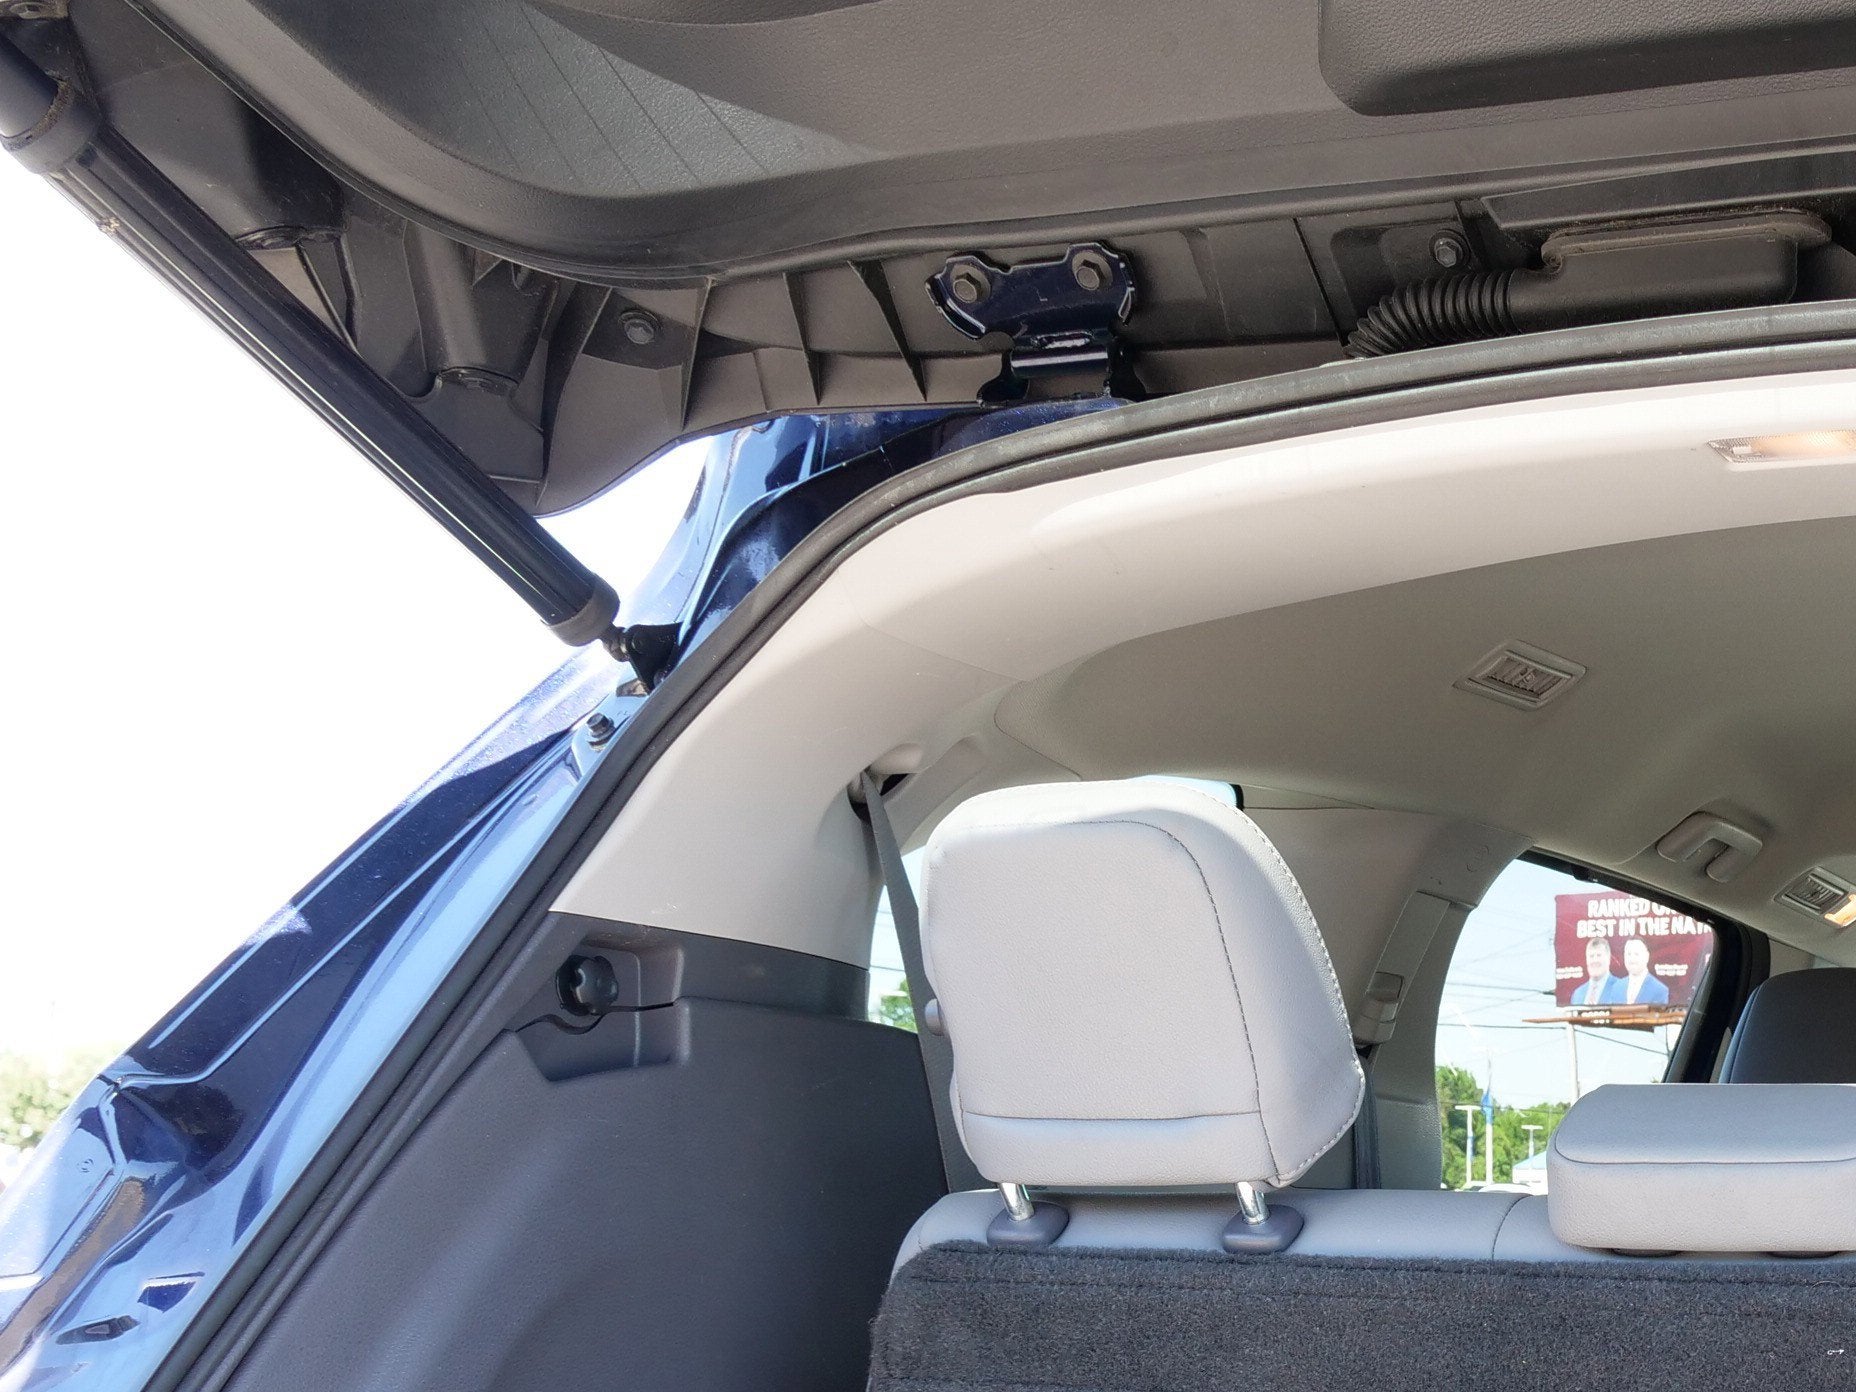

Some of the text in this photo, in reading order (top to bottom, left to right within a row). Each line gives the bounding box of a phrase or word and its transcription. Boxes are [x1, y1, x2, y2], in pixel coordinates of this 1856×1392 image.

[1588, 898, 1649, 918] RANKED
[1576, 919, 1616, 938] BEST
[1619, 918, 1636, 937] IN
[1638, 916, 1670, 936] THE
